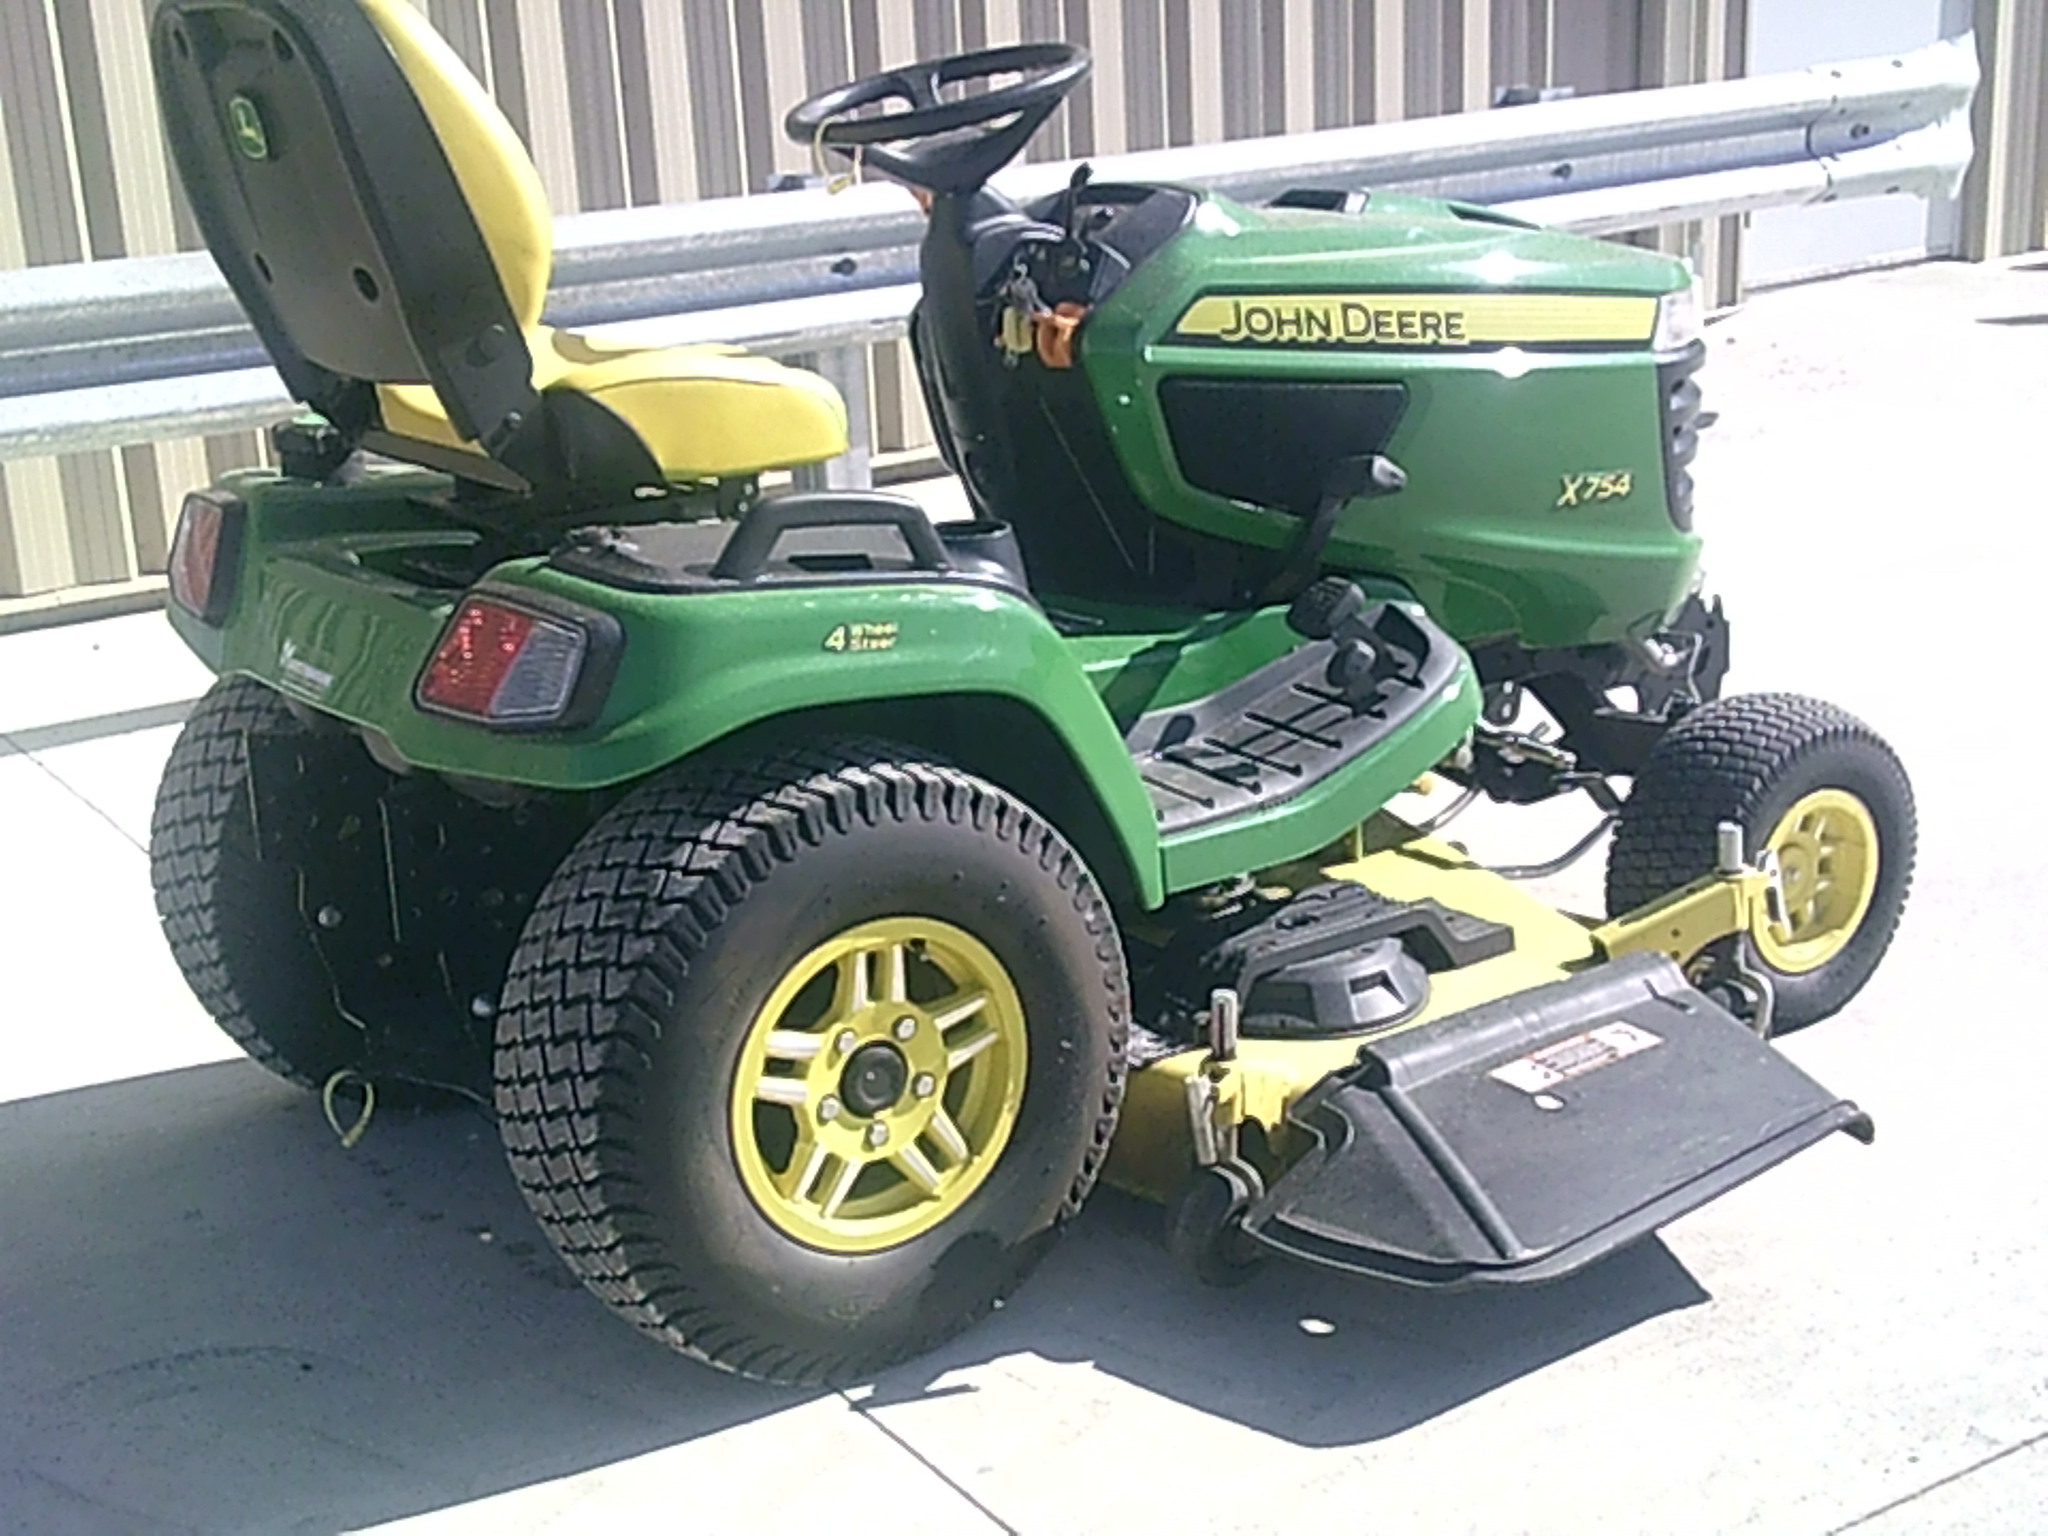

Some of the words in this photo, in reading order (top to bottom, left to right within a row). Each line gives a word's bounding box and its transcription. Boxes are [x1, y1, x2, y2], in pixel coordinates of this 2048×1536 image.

[1221, 301, 1329, 338] JOHN
[1341, 303, 1465, 339] DEERE
[1556, 469, 1632, 507] X754
[824, 625, 846, 651] 4
